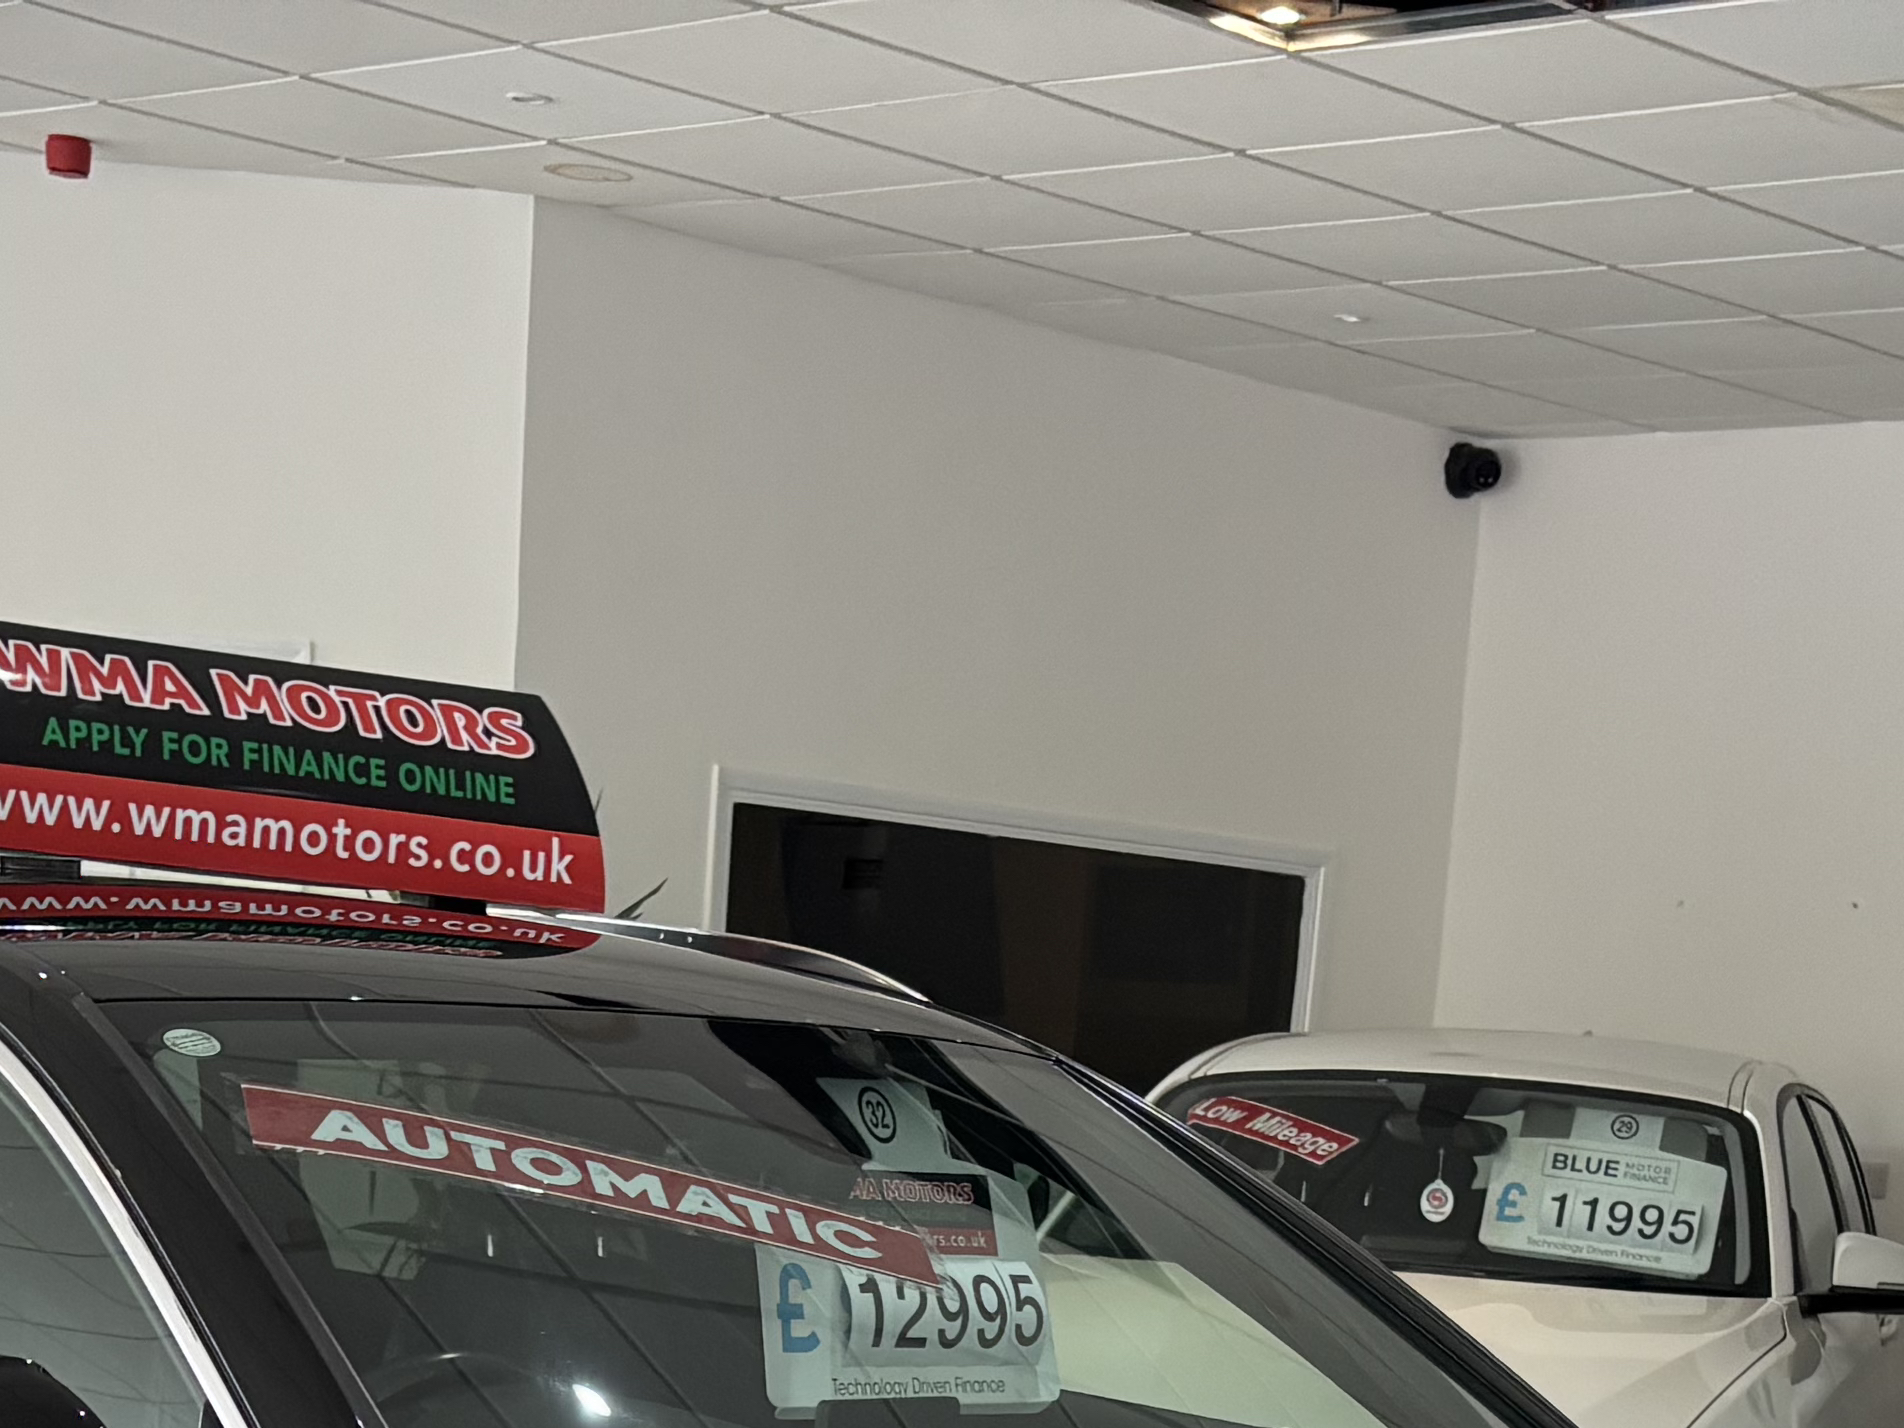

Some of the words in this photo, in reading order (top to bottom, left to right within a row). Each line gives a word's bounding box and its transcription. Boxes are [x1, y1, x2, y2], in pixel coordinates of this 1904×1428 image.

[211, 669, 535, 760] MOTORS
[41, 716, 150, 760] APPLY
[161, 731, 230, 769] FOR
[242, 743, 387, 788] FINANCE
[398, 762, 516, 804] ONLINE
[865, 1099, 891, 1131] 32
[1194, 1097, 1248, 1123] Low
[1245, 1112, 1340, 1156] Mileage
[1616, 1119, 1634, 1135] 29
[309, 1109, 883, 1260] AUTOMATIC
[1551, 1152, 1621, 1178] BLUE
[1625, 1162, 1672, 1175] MOTOR
[883, 1179, 975, 1205] MOTORS
[1496, 1182, 1528, 1223] £
[1551, 1193, 1696, 1245] 11995
[777, 1263, 820, 1353] £
[858, 1273, 1044, 1350] 12995
[831, 1377, 908, 1398] Technology
[912, 1377, 952, 1394] Driven
[955, 1377, 1006, 1394] Finance
